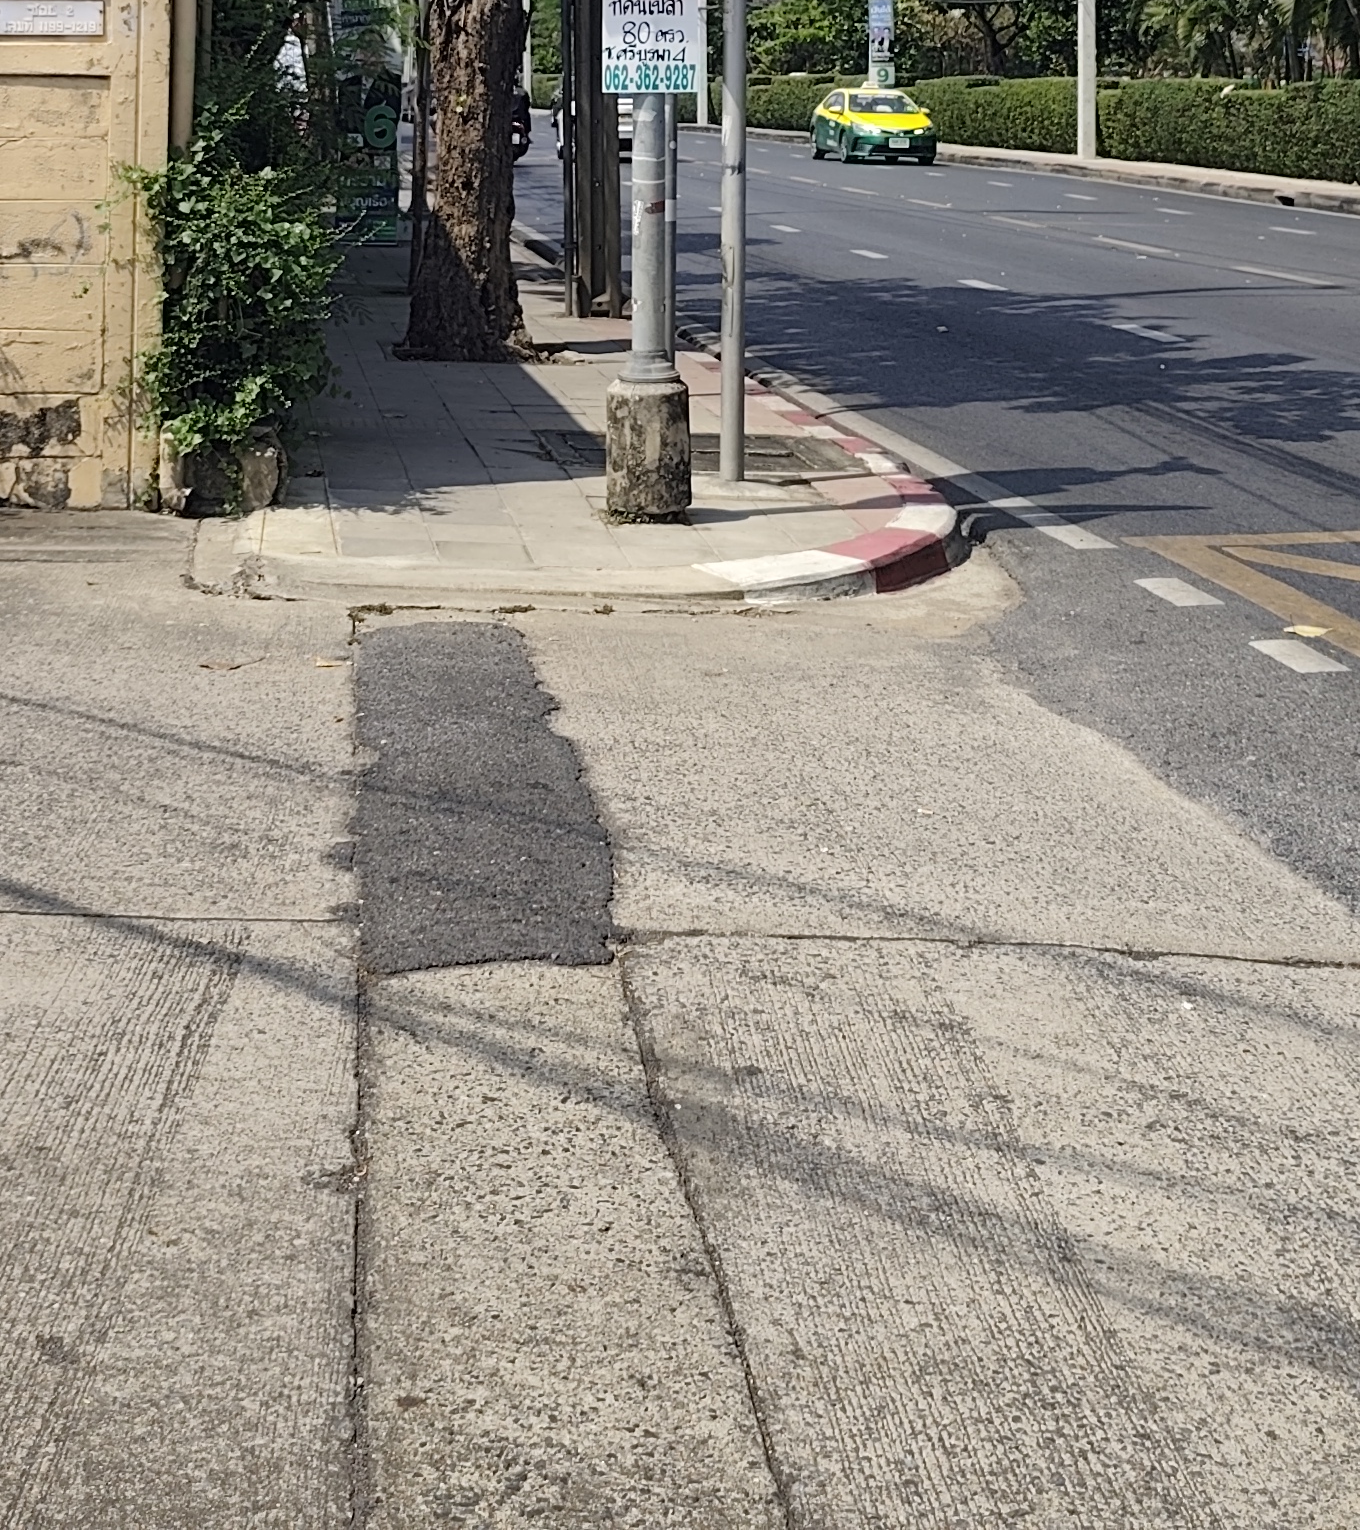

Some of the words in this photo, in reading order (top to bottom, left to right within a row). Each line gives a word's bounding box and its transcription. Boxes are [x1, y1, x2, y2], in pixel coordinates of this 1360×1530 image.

[622, 21, 651, 45] 80
[605, 64, 696, 91] 062-362-9287
[877, 68, 889, 83] 9
[364, 104, 397, 148] 6
